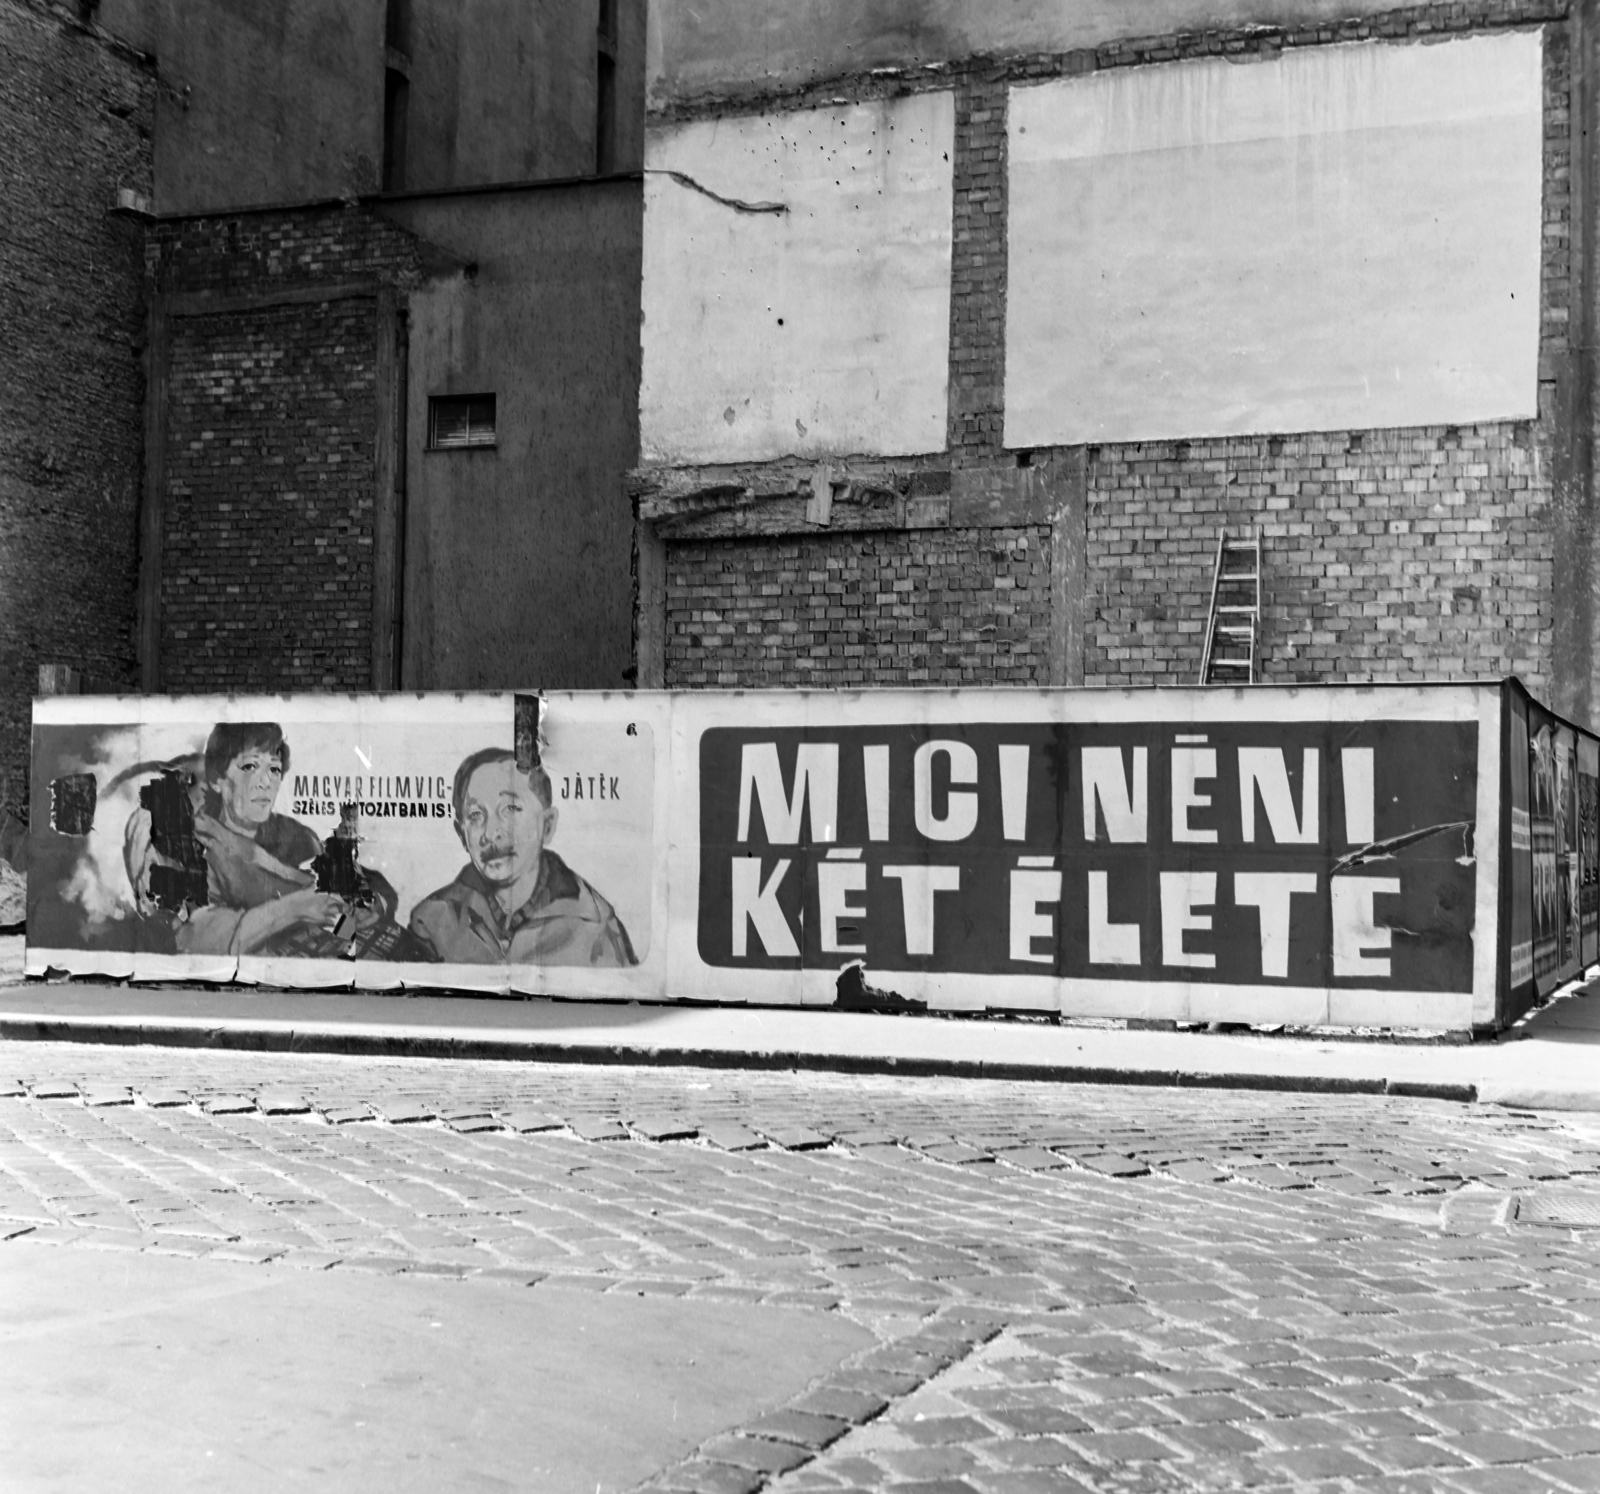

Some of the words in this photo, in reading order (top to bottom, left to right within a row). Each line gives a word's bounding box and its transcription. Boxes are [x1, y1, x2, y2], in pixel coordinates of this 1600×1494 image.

[294, 775, 363, 798] MAGYAR
[369, 775, 452, 799] FILMVIG-
[561, 771, 620, 800] JÁTÉK
[737, 739, 1030, 844] MICI
[1081, 734, 1374, 844] NÉNI
[732, 848, 960, 957] KÉT
[1009, 855, 1400, 977] ÉLETE
